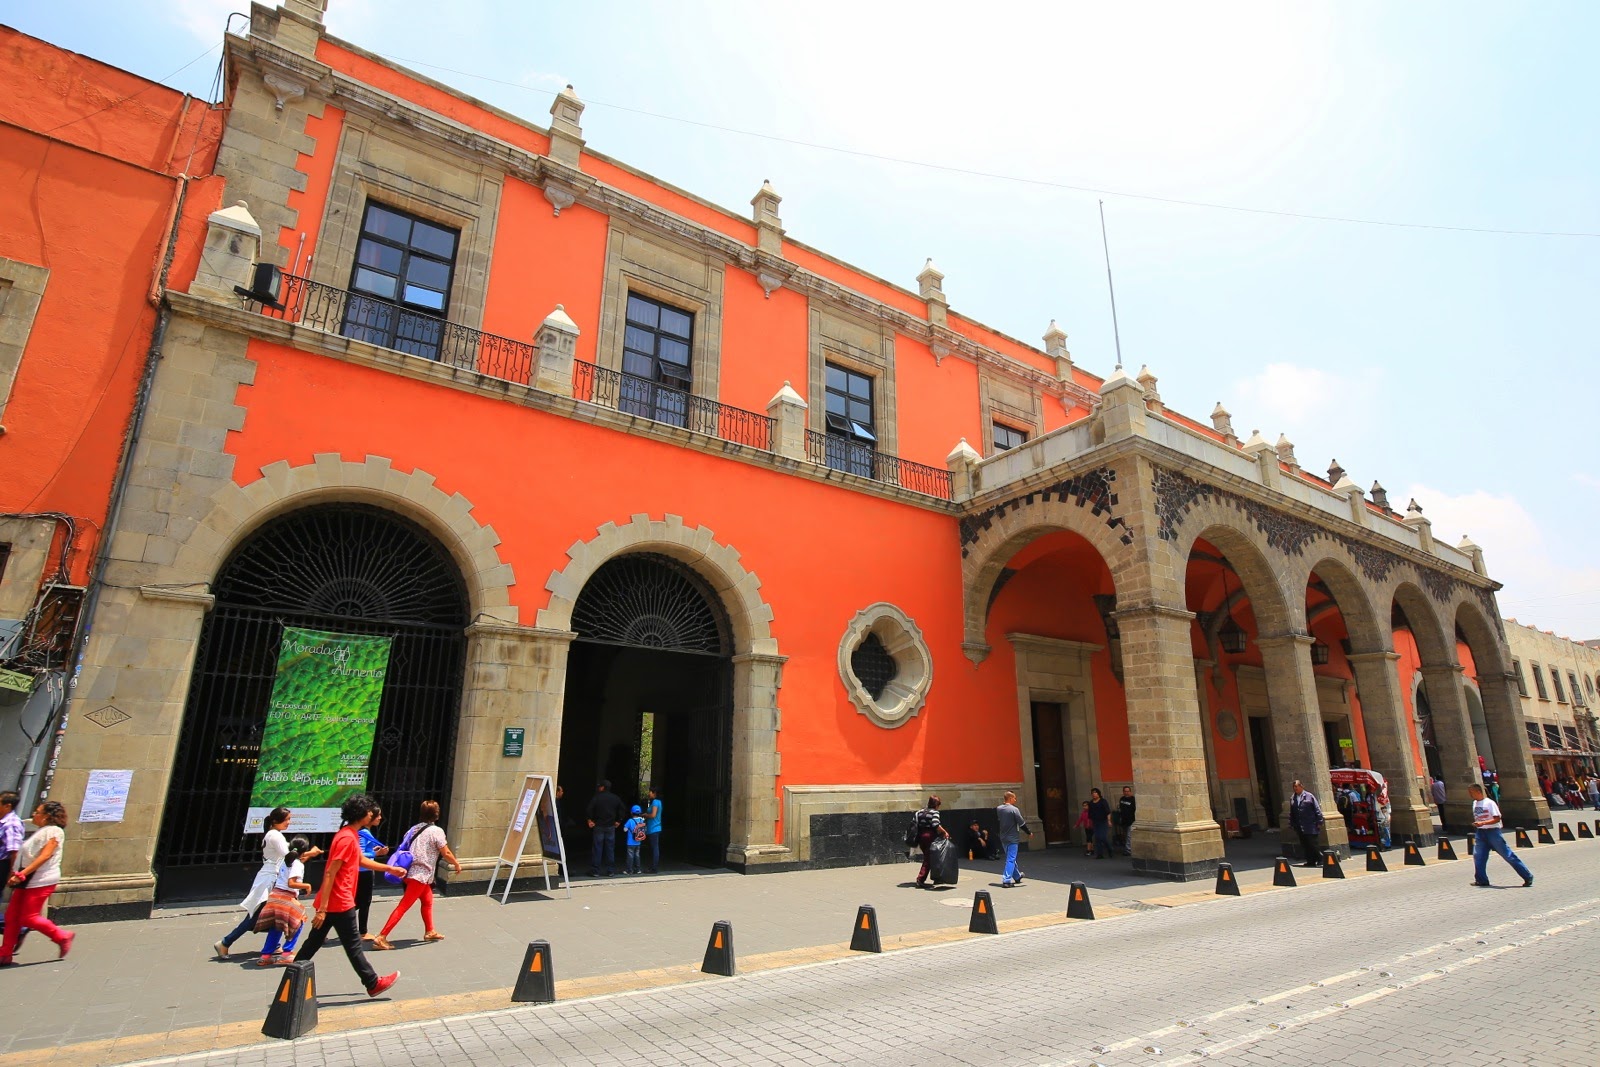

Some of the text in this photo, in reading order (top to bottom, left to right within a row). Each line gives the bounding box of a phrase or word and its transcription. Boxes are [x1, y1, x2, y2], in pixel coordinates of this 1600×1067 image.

[282, 640, 333, 655] Morada
[261, 771, 289, 782] Teatro
[302, 775, 334, 786] Pueblo
